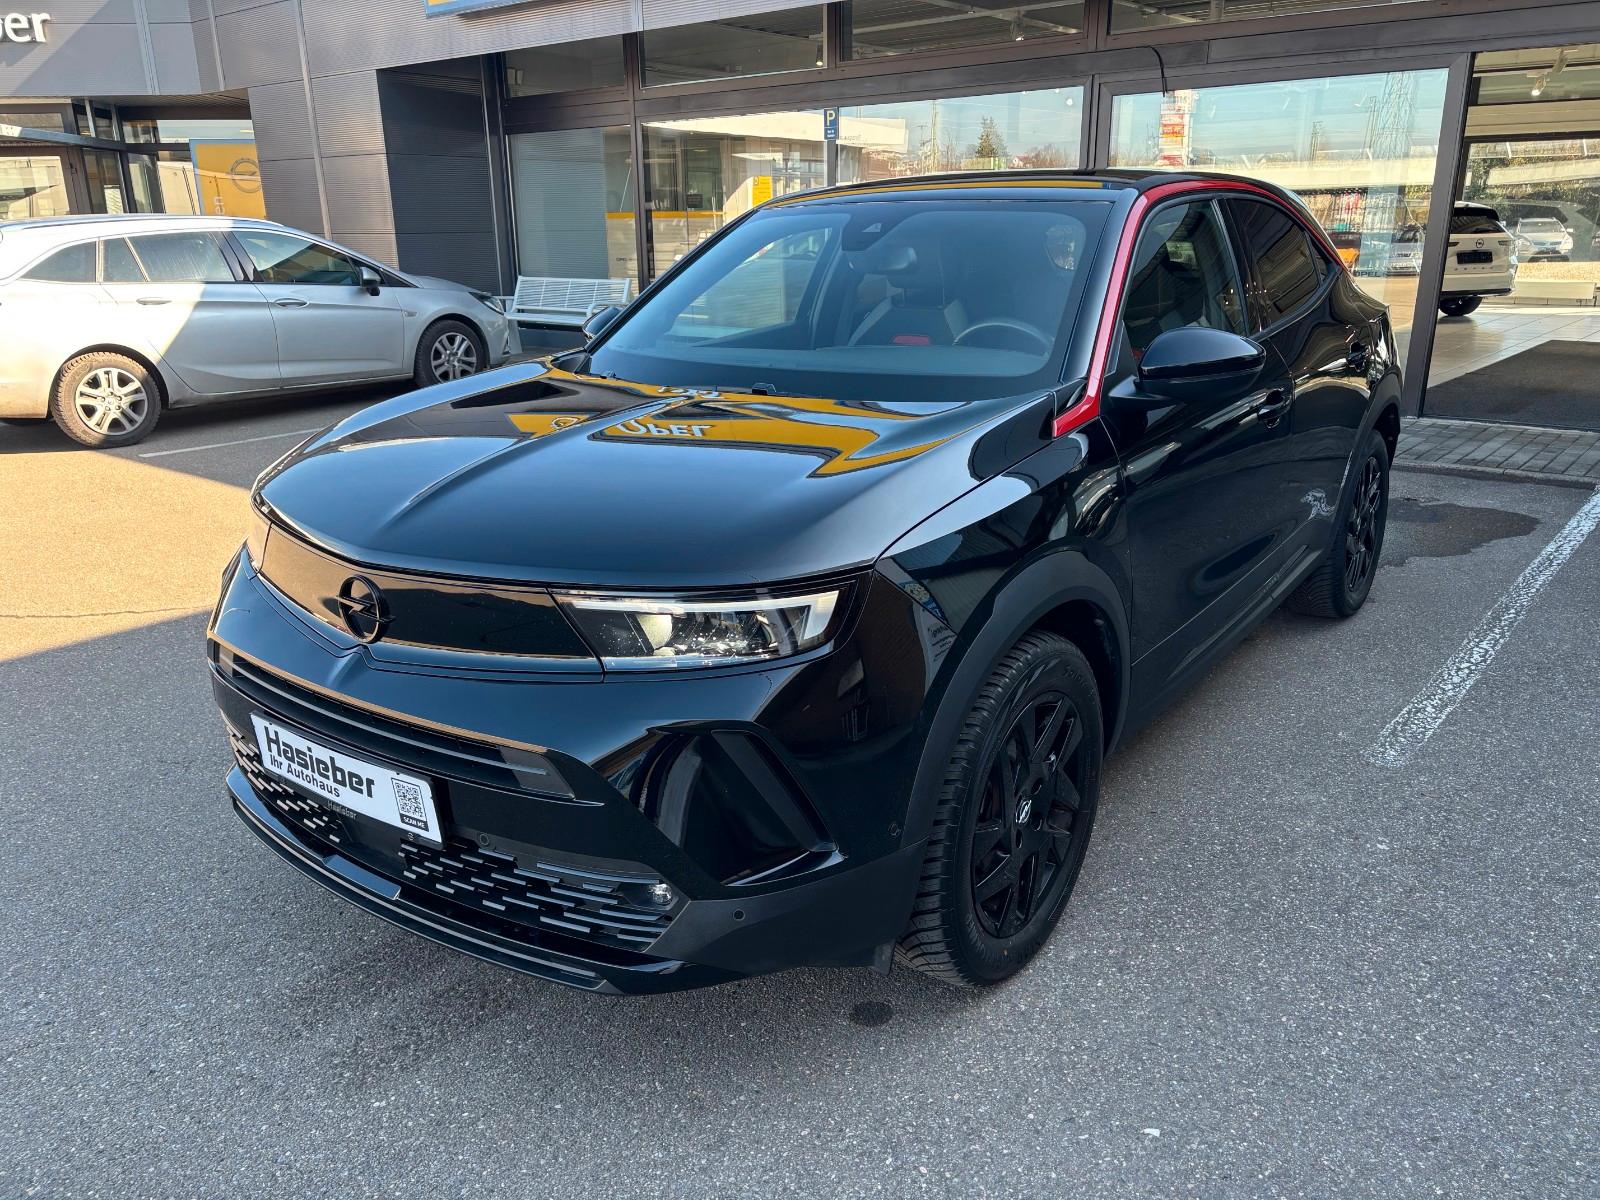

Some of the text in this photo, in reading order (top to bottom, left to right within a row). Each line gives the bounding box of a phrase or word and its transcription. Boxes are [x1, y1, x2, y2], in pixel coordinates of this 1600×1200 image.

[0, 12, 51, 43] er
[826, 110, 836, 127] P
[264, 725, 375, 799] Hasieber
[269, 754, 341, 798] Ihr Autohaus
[403, 816, 417, 826] SCAN
